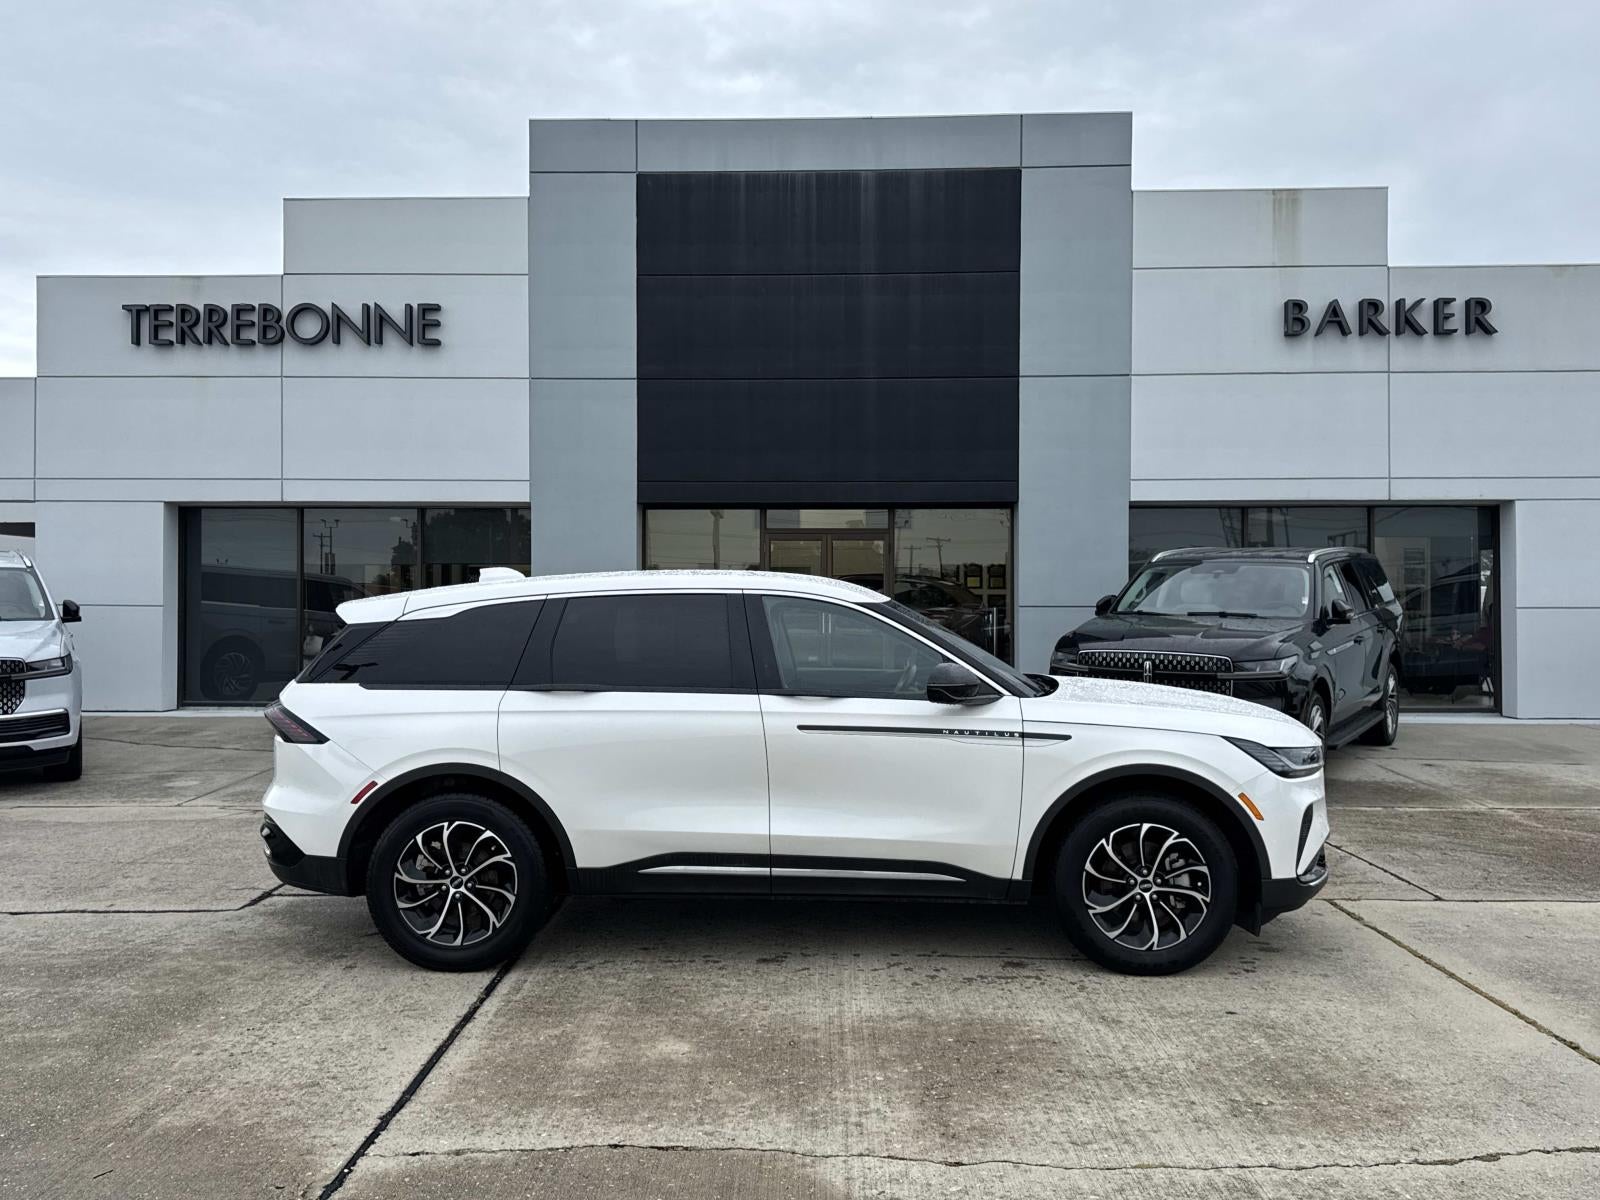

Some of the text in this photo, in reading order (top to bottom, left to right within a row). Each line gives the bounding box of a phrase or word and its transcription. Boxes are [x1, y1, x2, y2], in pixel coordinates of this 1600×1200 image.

[122, 302, 442, 346] TERREBONNE
[1284, 297, 1498, 336] BARKER
[942, 729, 1020, 737] NAUTILUS
